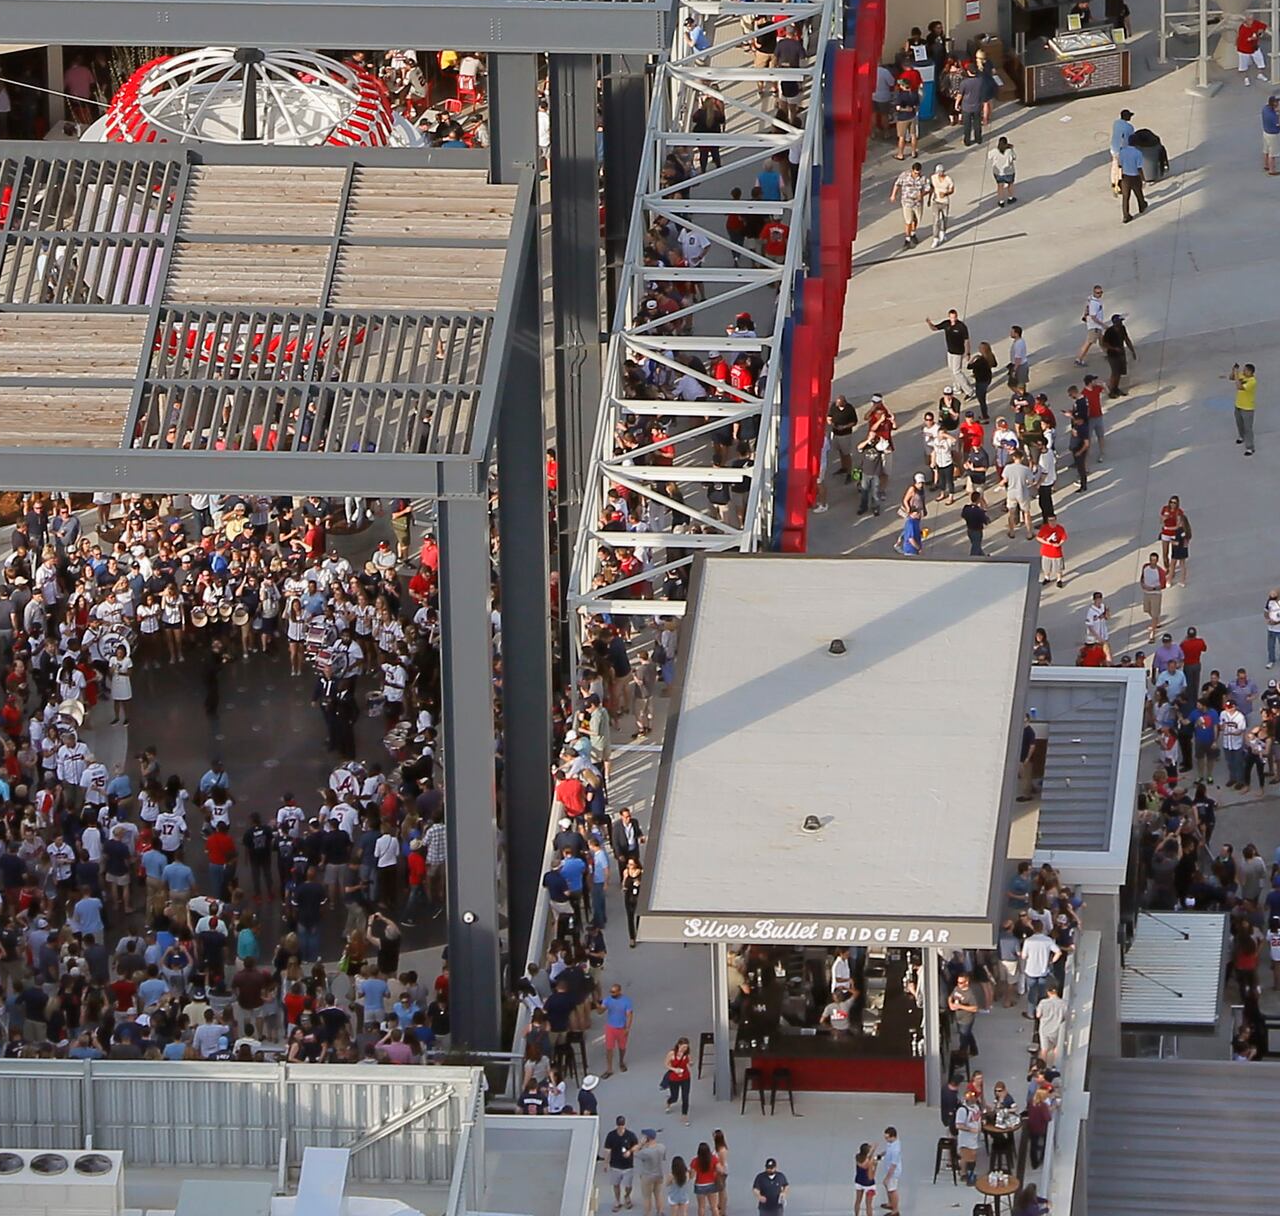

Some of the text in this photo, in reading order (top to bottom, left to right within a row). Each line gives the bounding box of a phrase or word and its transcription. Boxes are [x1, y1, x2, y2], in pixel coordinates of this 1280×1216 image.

[161, 824, 174, 836] 17
[683, 918, 951, 943] Silver Bullet BRIDGE BAR
